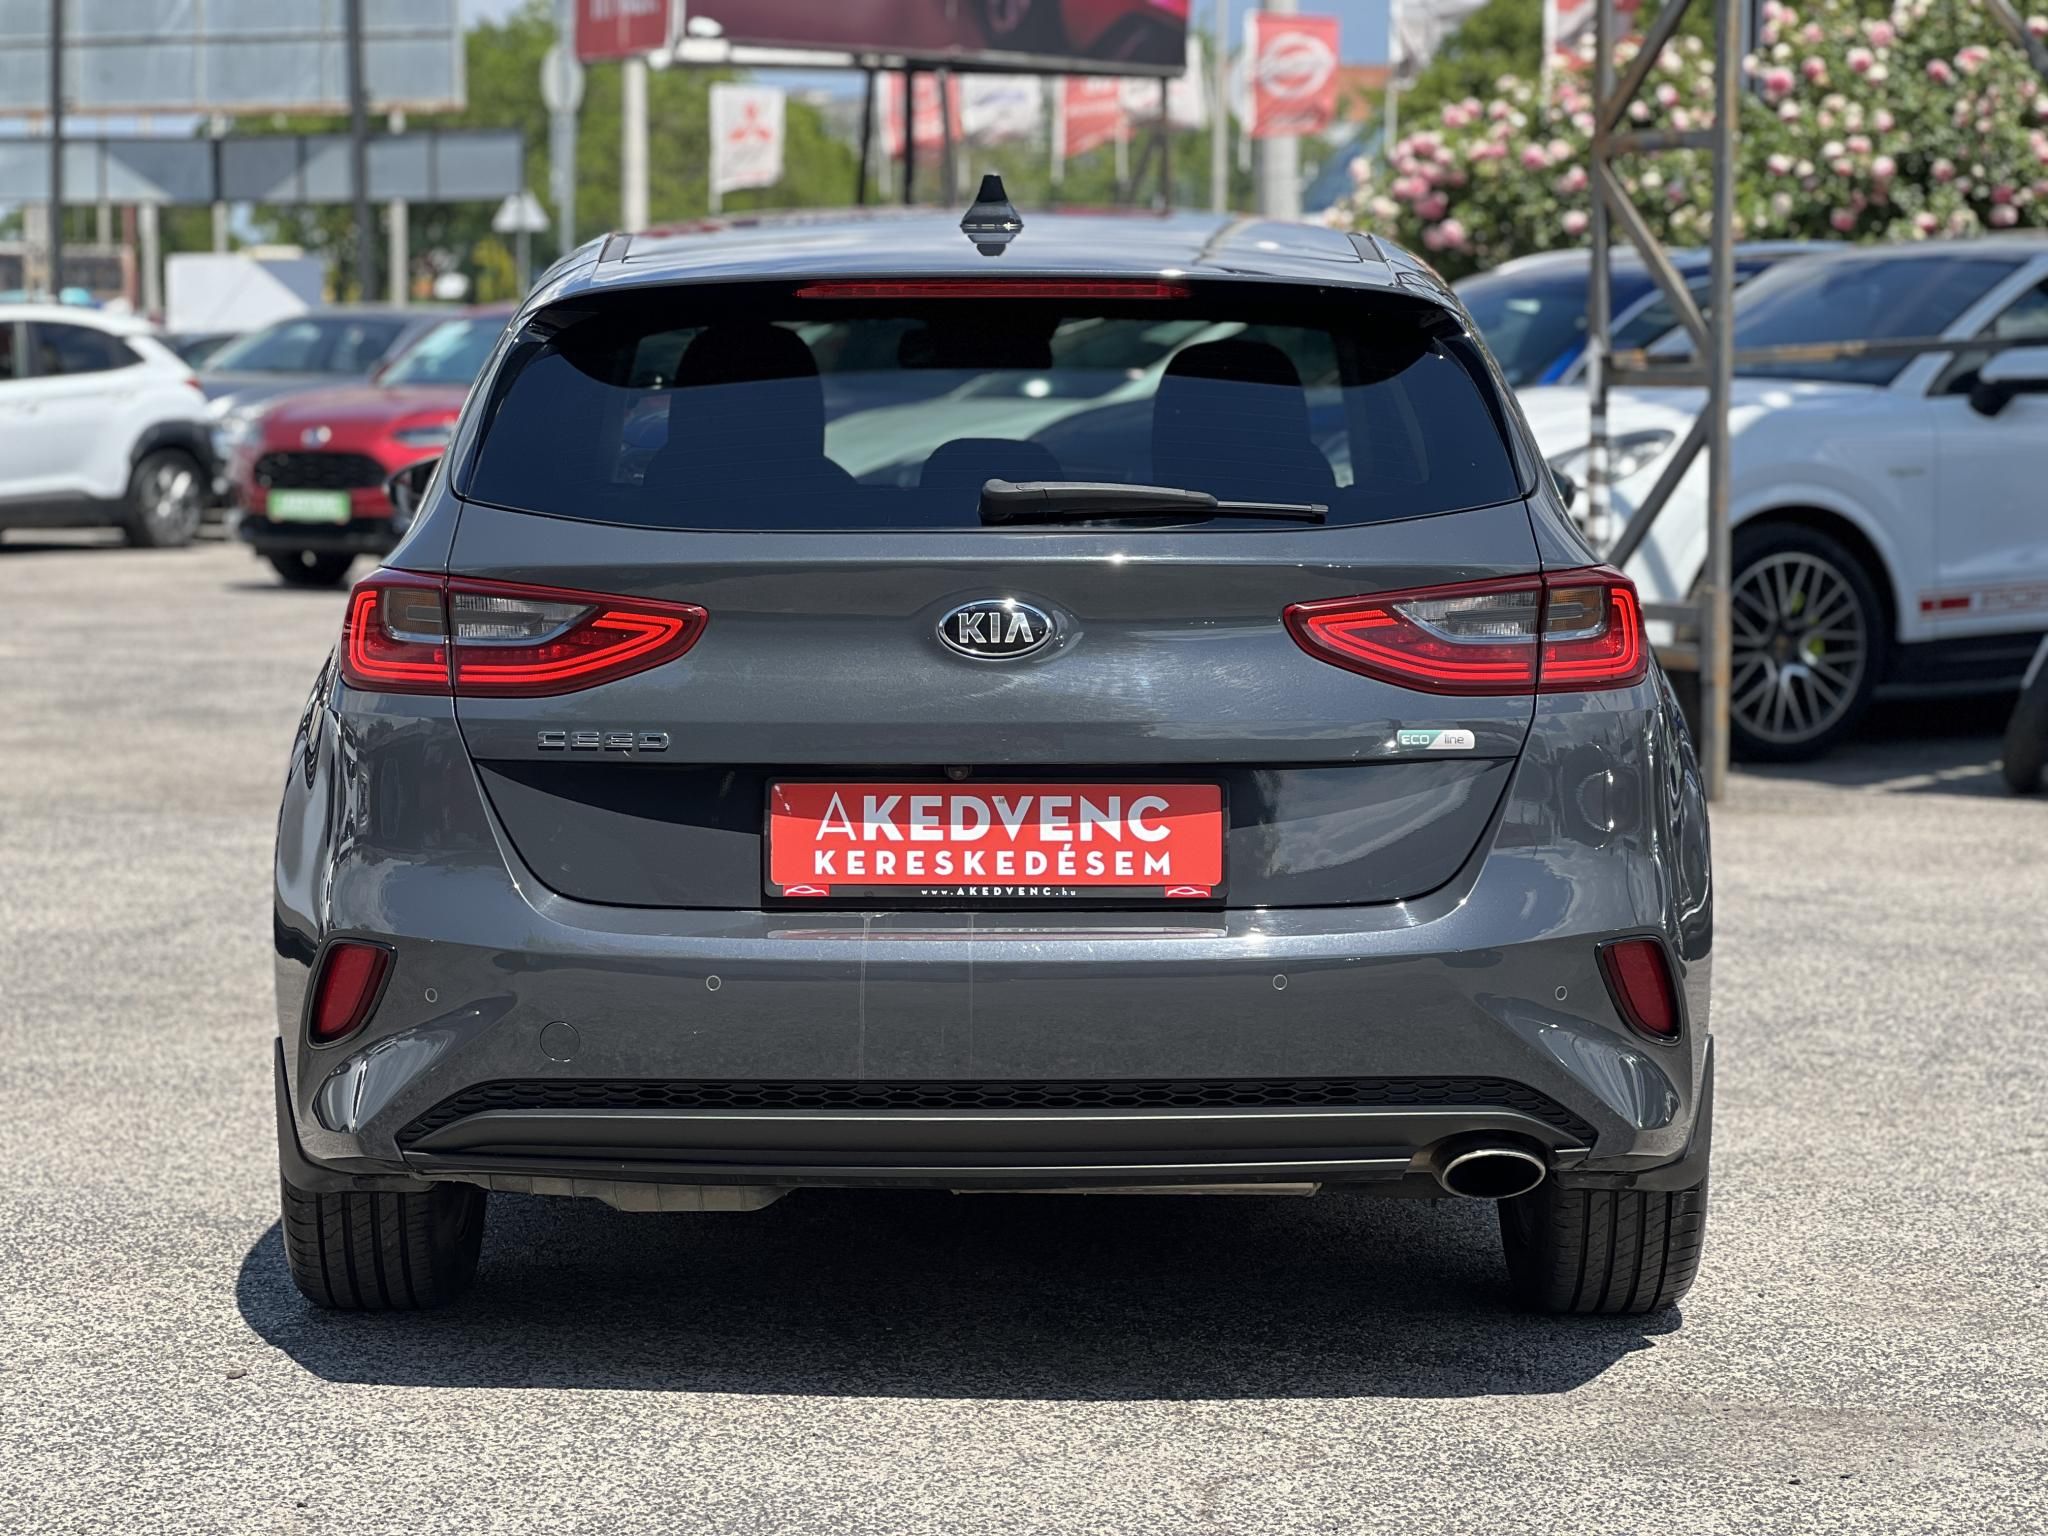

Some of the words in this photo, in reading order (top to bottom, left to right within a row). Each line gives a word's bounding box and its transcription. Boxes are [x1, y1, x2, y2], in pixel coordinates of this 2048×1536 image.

[958, 612, 1034, 643] KIA
[537, 731, 669, 751] CEED
[1401, 734, 1430, 745] ECO
[1444, 734, 1465, 745] line
[814, 845, 1170, 876] KERESKEDÉSEM
[921, 887, 1077, 896] www.AKEDVENC.hu
